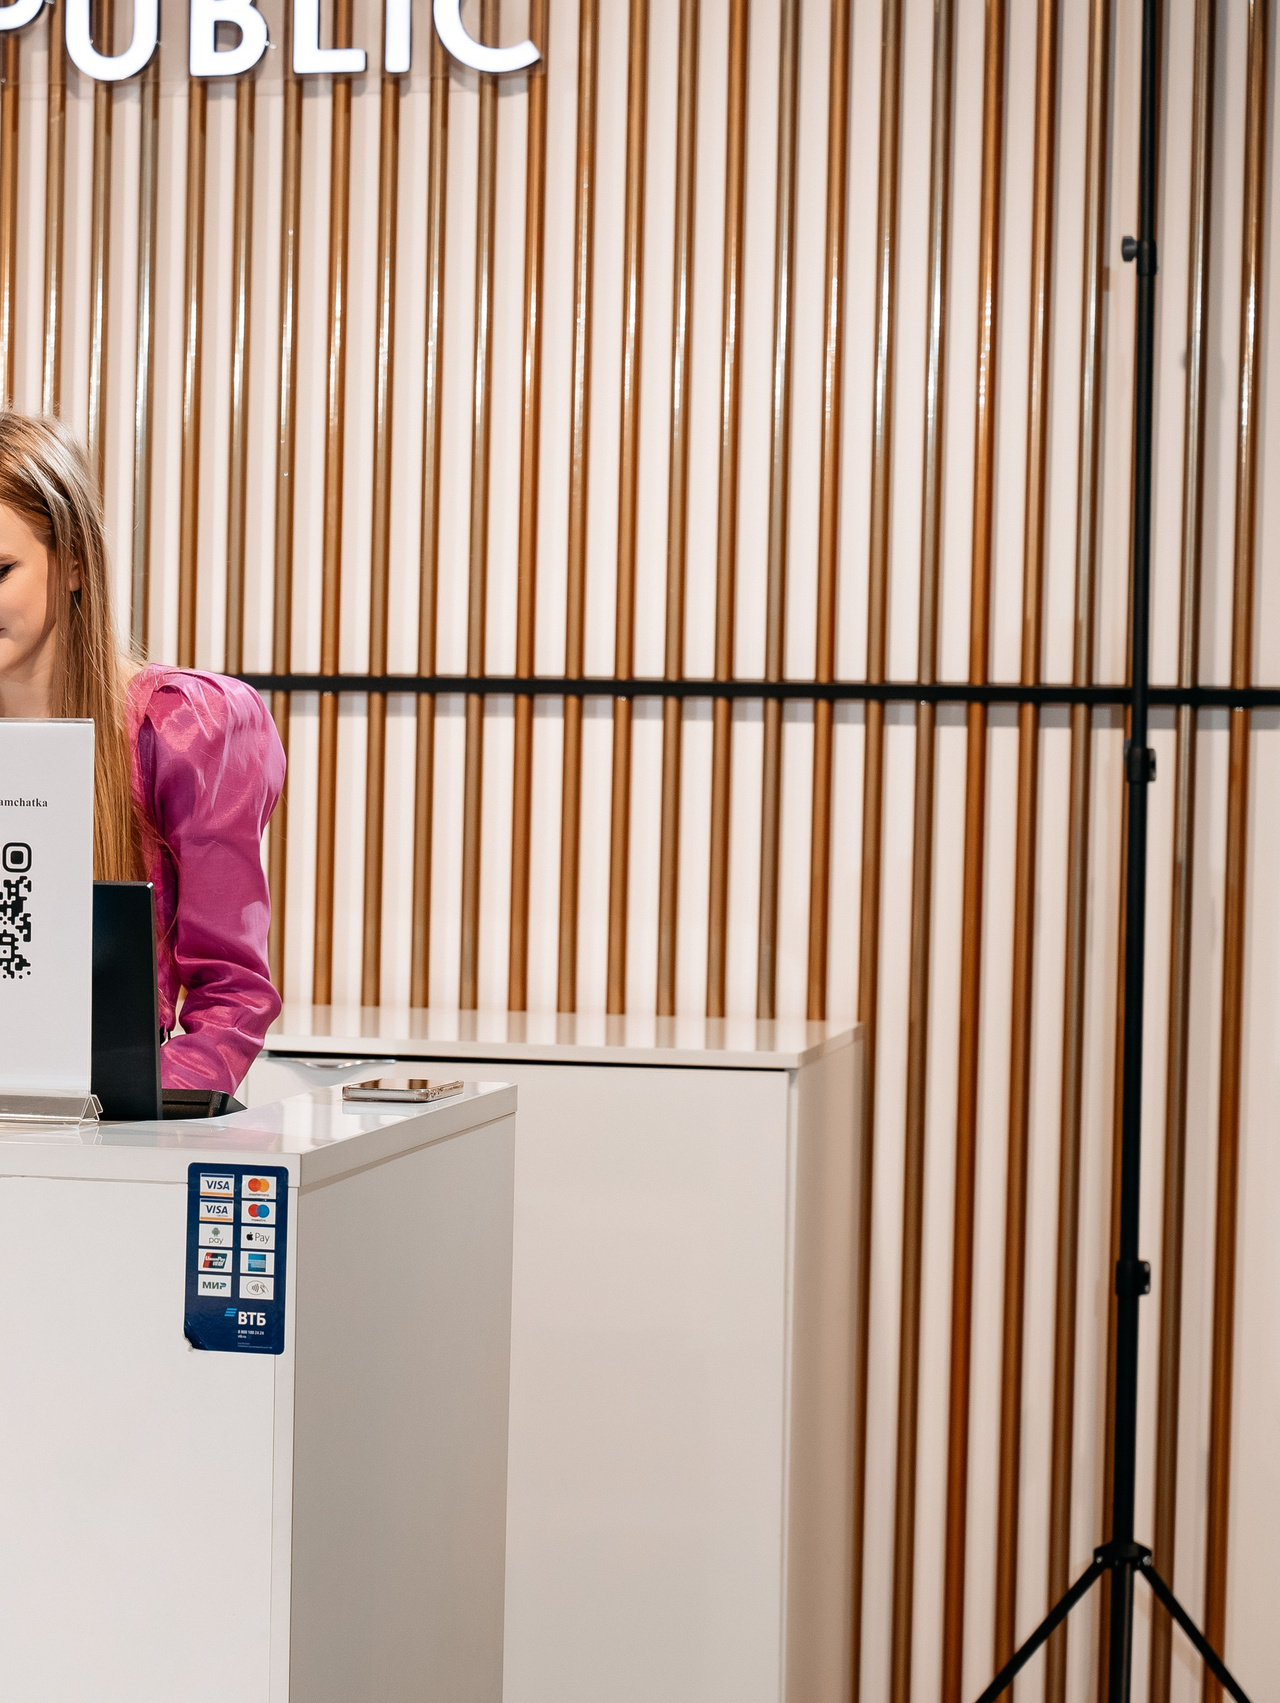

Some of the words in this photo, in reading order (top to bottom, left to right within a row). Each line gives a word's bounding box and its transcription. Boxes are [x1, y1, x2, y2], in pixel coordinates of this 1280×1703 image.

[205, 1179, 230, 1191] VISA
[205, 1204, 229, 1215] VISA
[208, 1237, 224, 1245] pay
[254, 1232, 271, 1245] Pay
[202, 1281, 227, 1290] МИР
[237, 1311, 267, 1327] ВТБ
